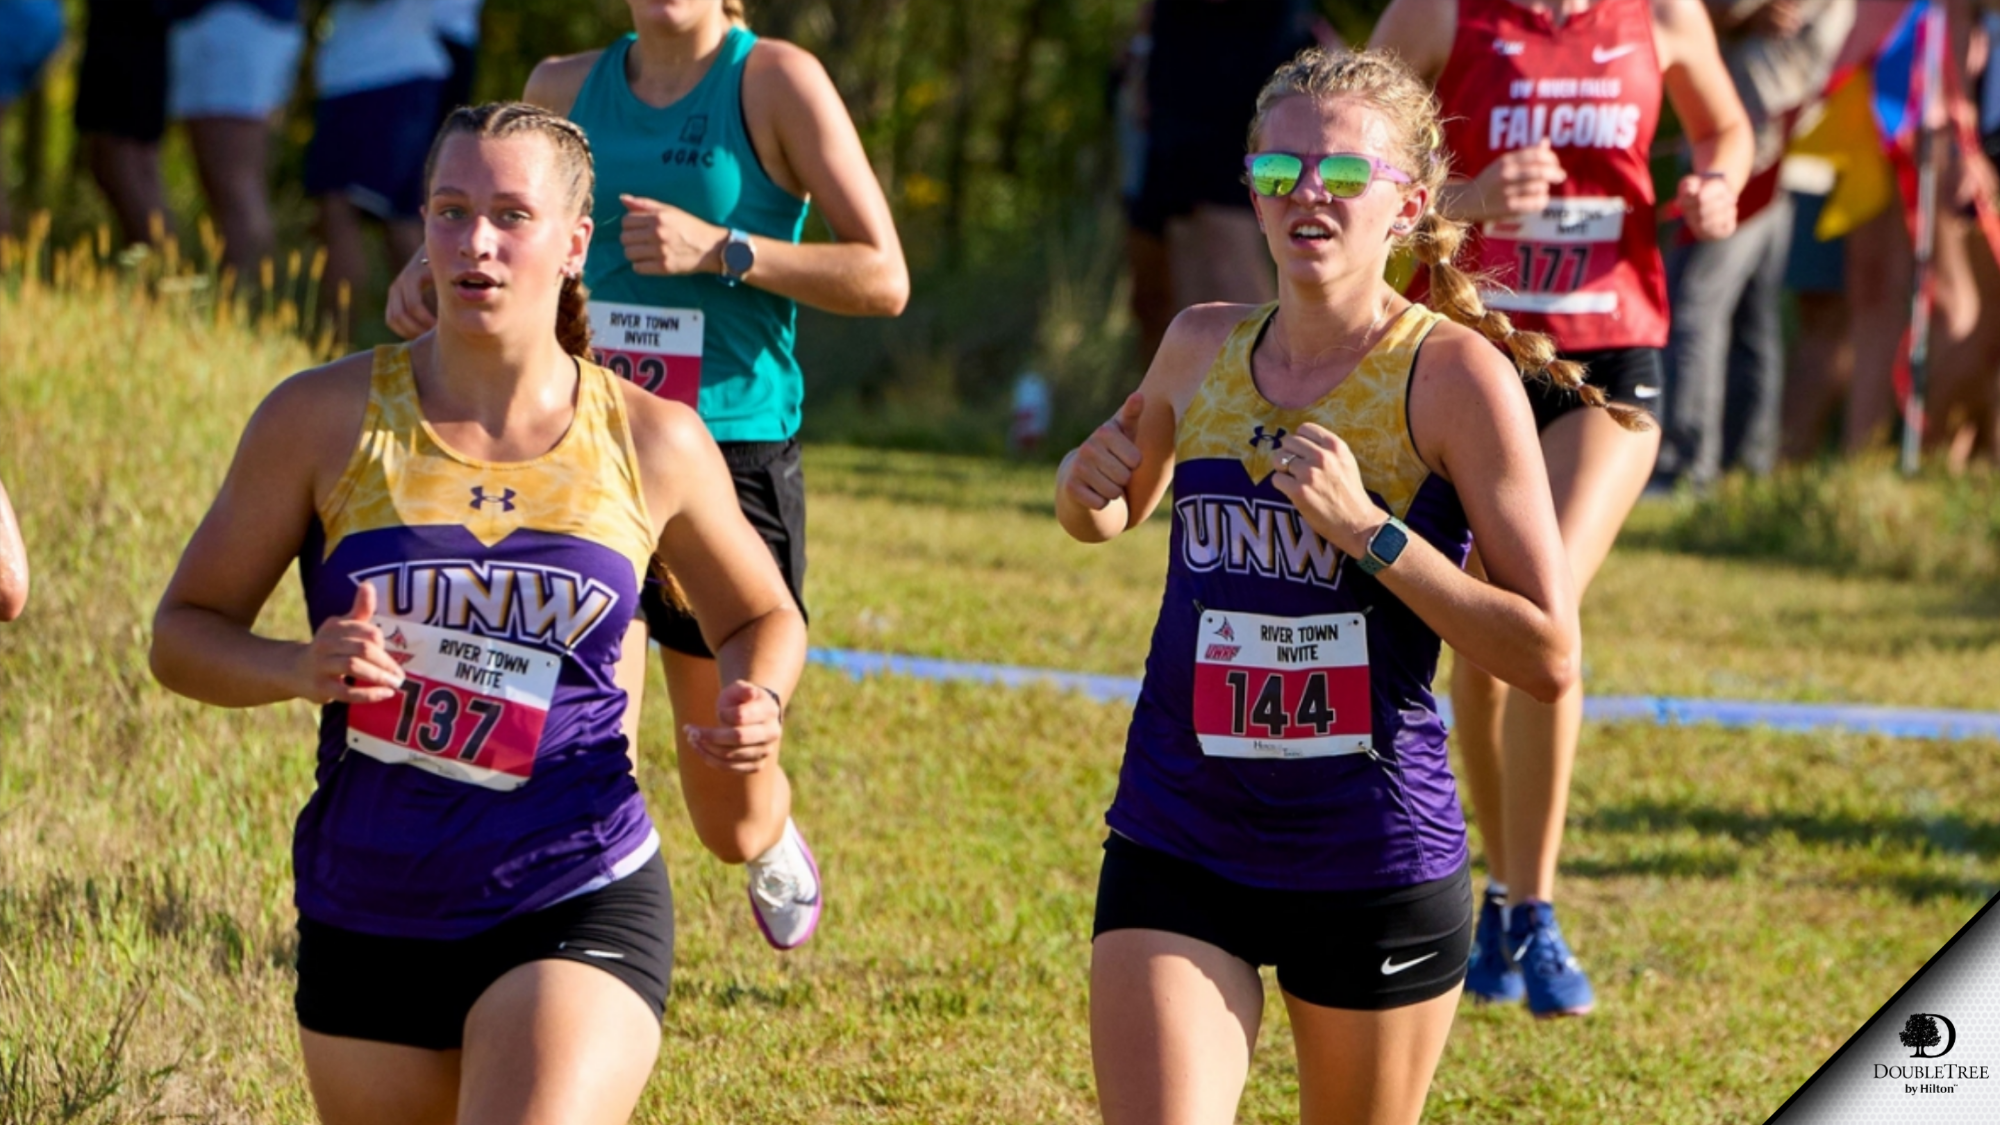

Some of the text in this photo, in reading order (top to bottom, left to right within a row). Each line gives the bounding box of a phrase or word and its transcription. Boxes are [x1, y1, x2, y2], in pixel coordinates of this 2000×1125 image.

[1514, 242, 1592, 293] 177
[610, 312, 680, 331] RIVER TOWN
[624, 331, 660, 347] INVITE
[1176, 494, 1346, 590] UNW
[348, 559, 619, 650] UNW
[1261, 624, 1339, 643] RIVER TOWN
[439, 639, 481, 662] RIVER
[486, 650, 530, 675] TOWN
[1277, 645, 1319, 663] INVITE
[455, 662, 504, 689] INVITE
[393, 677, 505, 764] 137
[1226, 670, 1337, 738] 144
